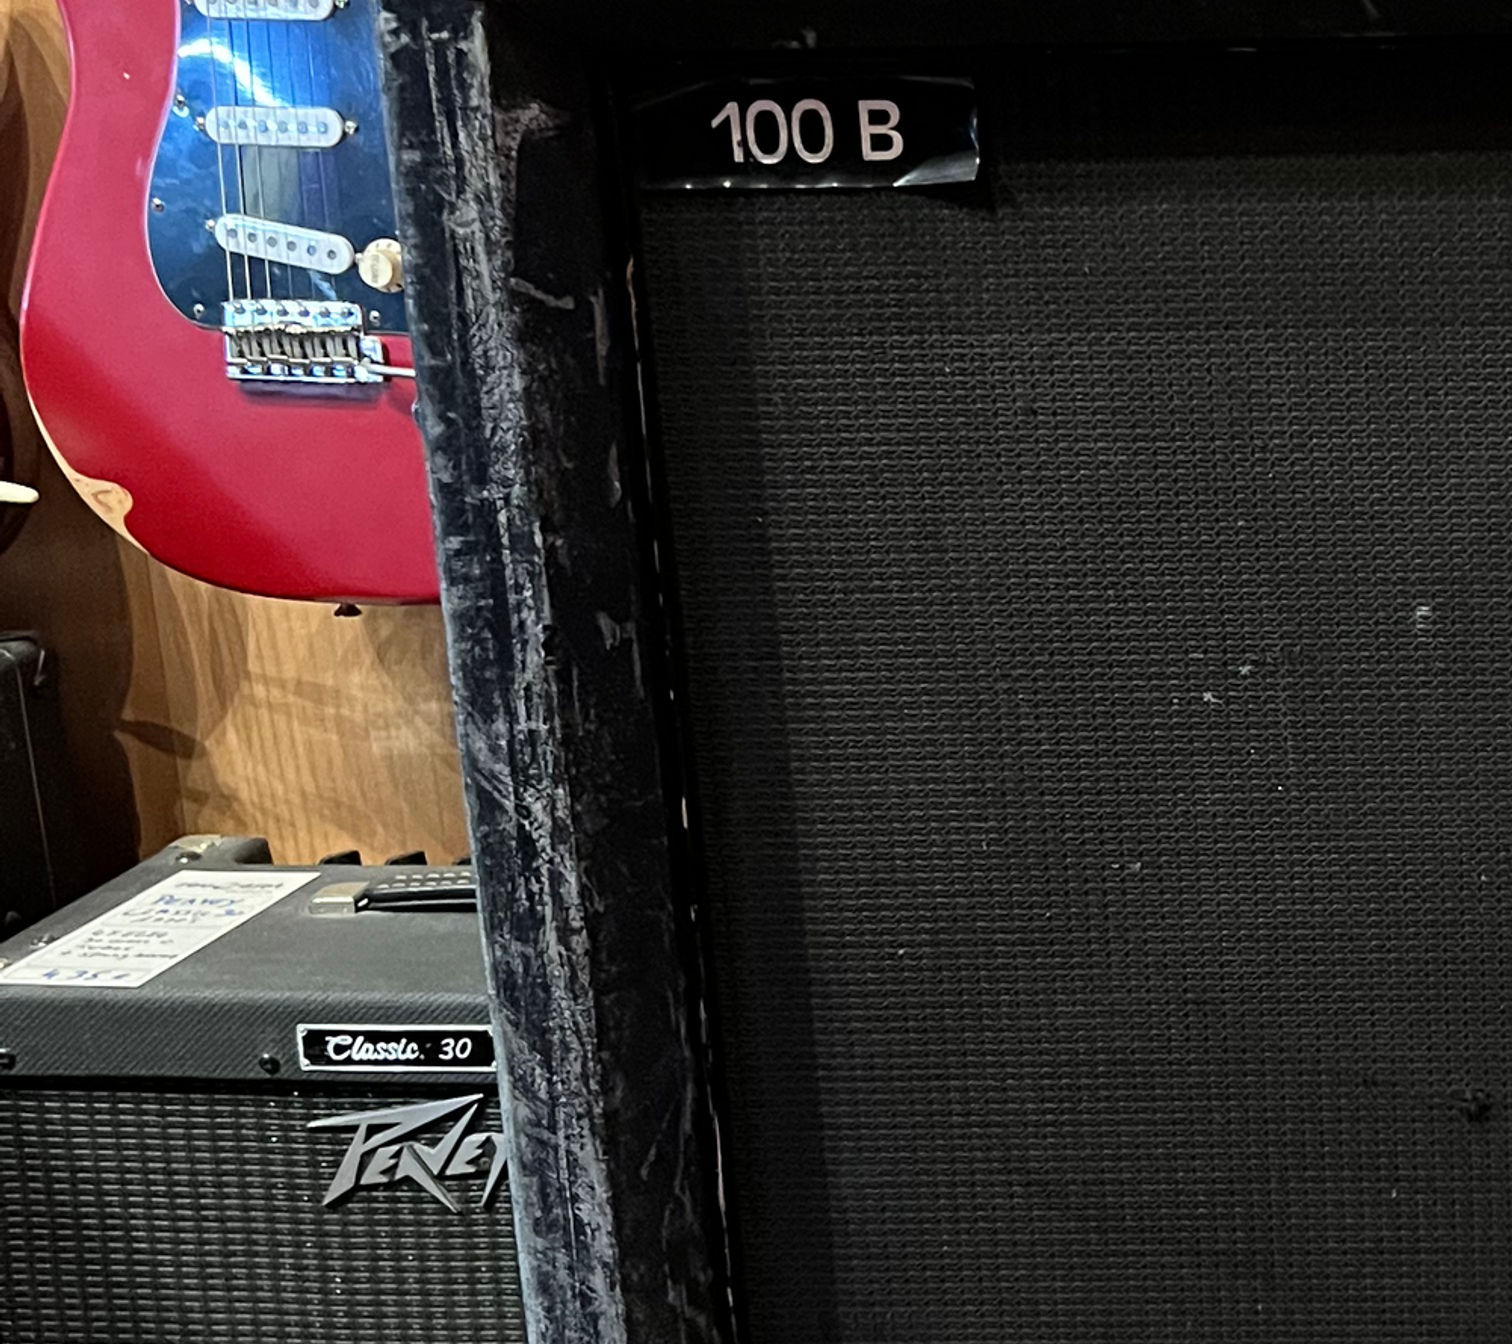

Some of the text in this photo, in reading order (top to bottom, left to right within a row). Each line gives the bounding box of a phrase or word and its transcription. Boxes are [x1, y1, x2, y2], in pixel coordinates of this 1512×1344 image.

[710, 98, 904, 165] 100 B
[438, 1037, 473, 1060] 30
